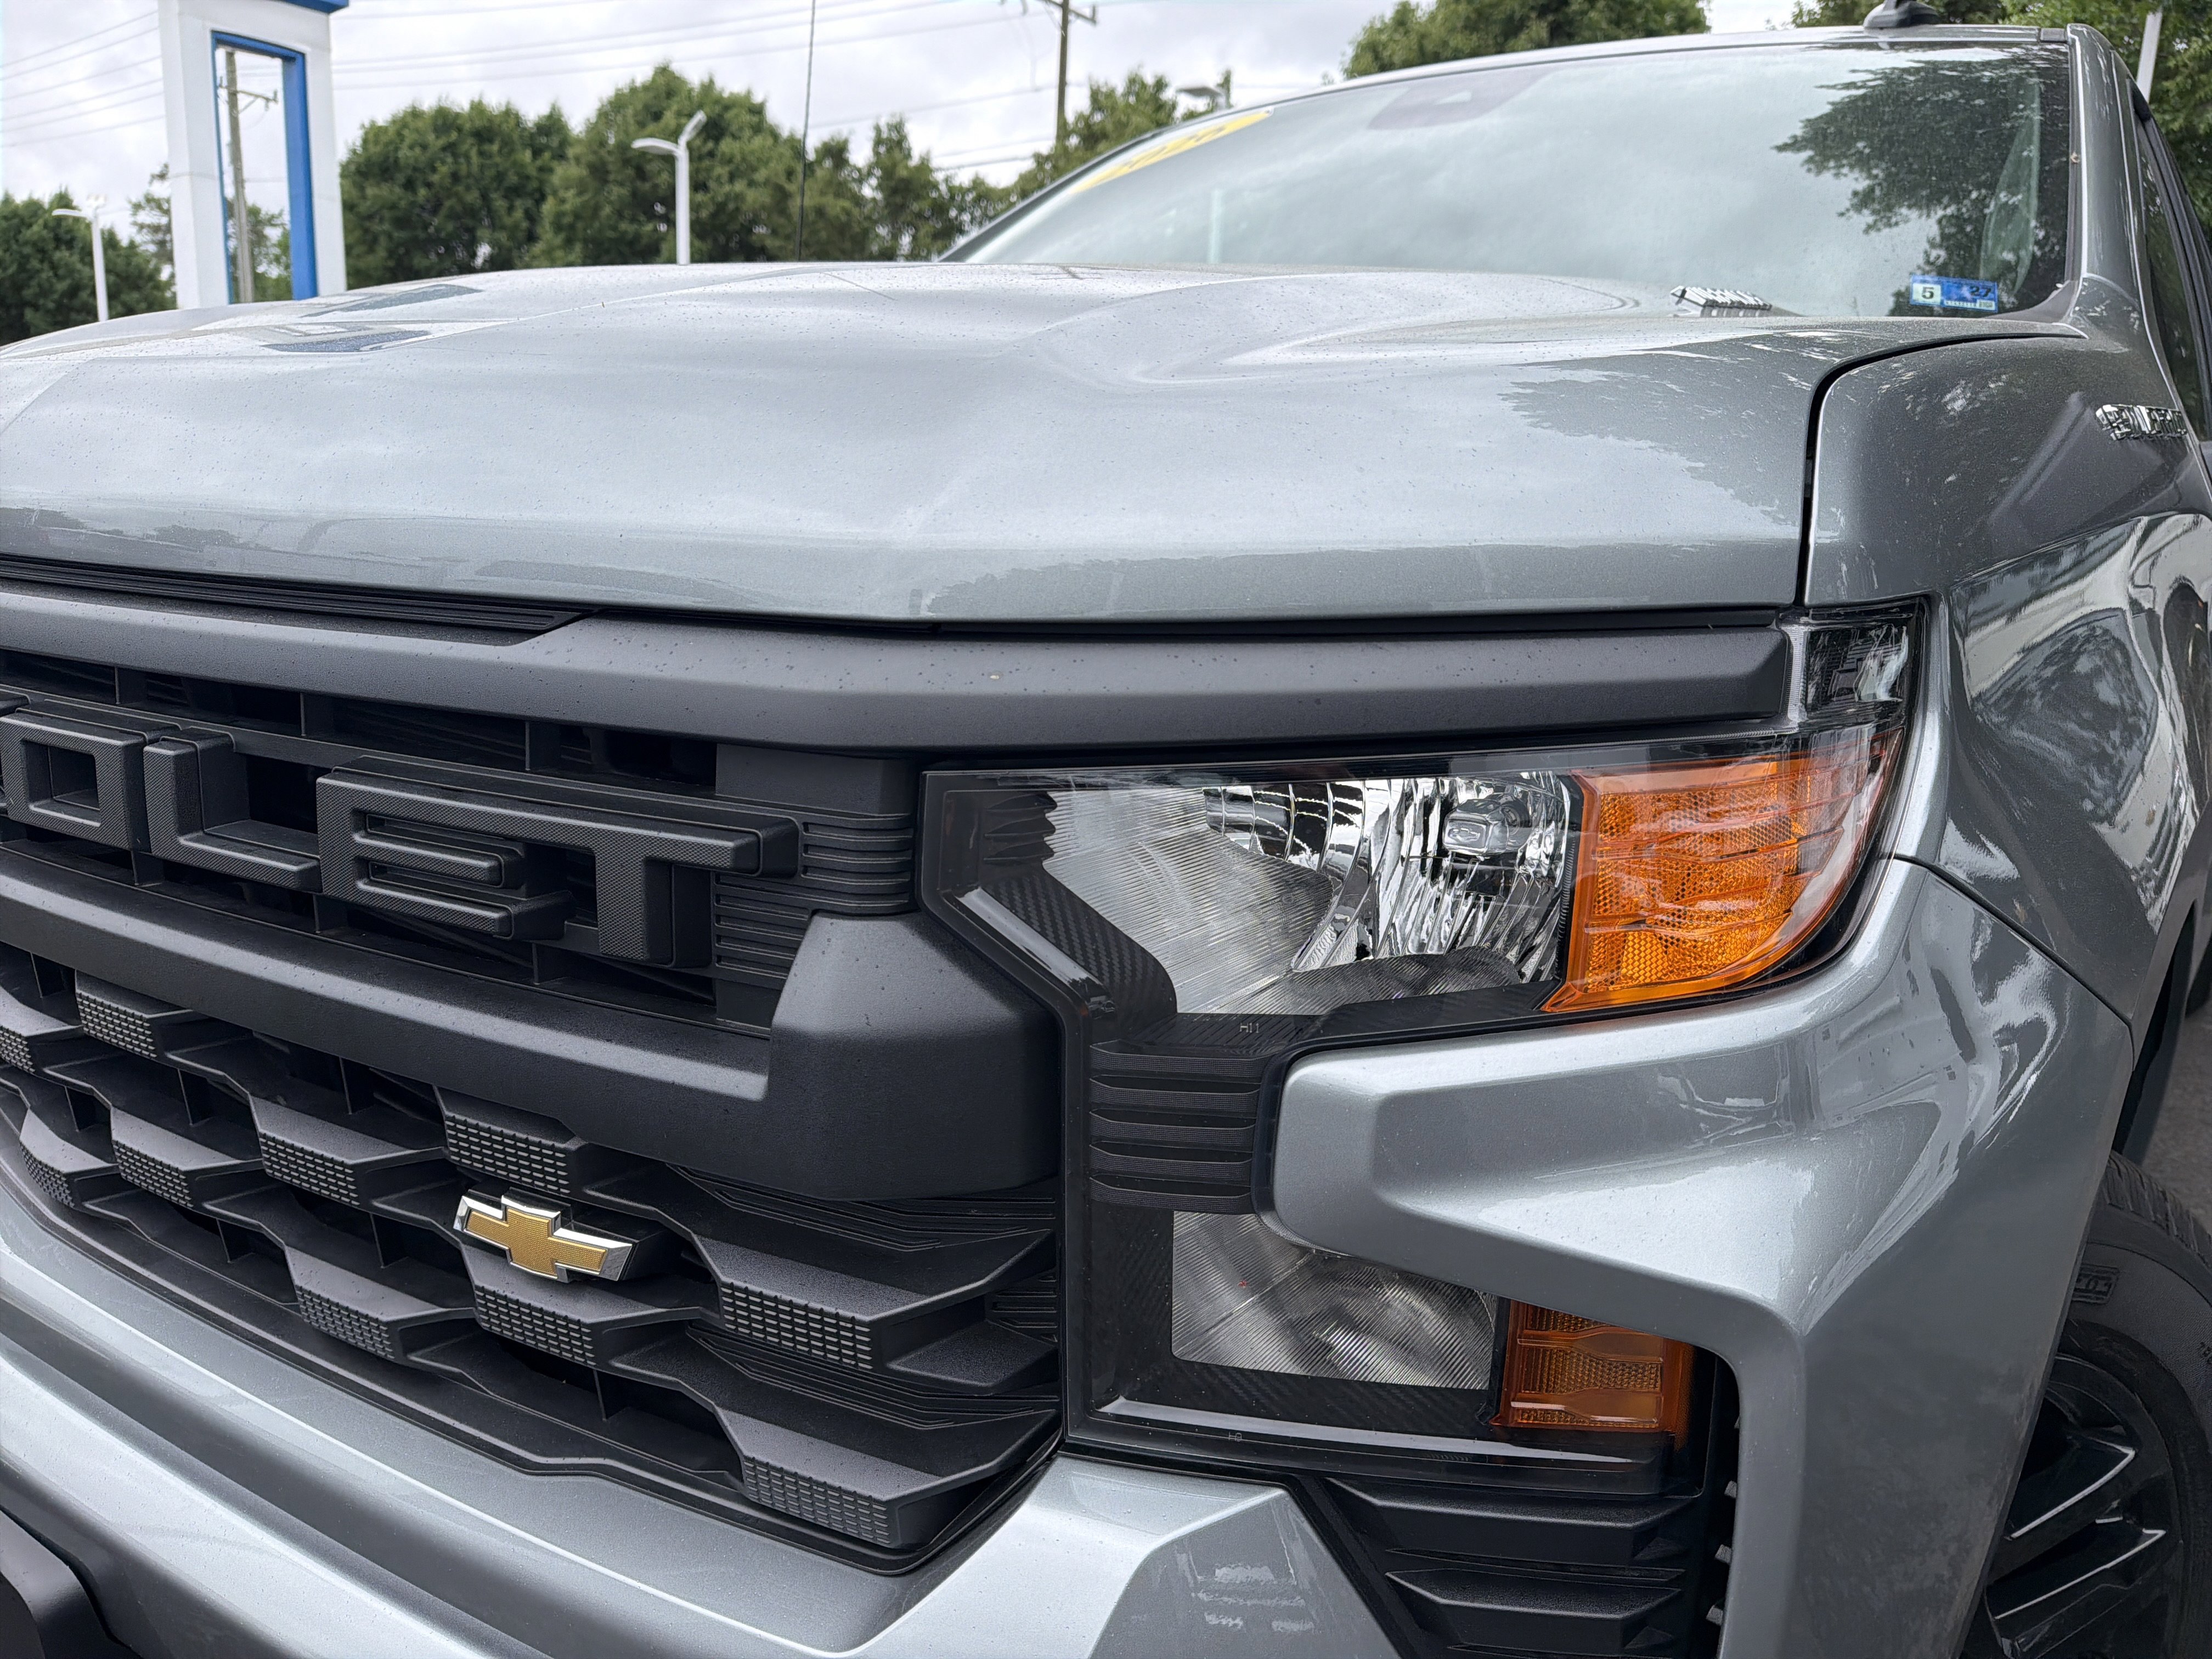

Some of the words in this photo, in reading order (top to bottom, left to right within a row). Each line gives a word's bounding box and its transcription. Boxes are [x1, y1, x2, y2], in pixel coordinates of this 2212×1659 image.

[1922, 287, 1934, 300] 5
[1970, 285, 1992, 298] 27
[1240, 1023, 1259, 1034] H11
